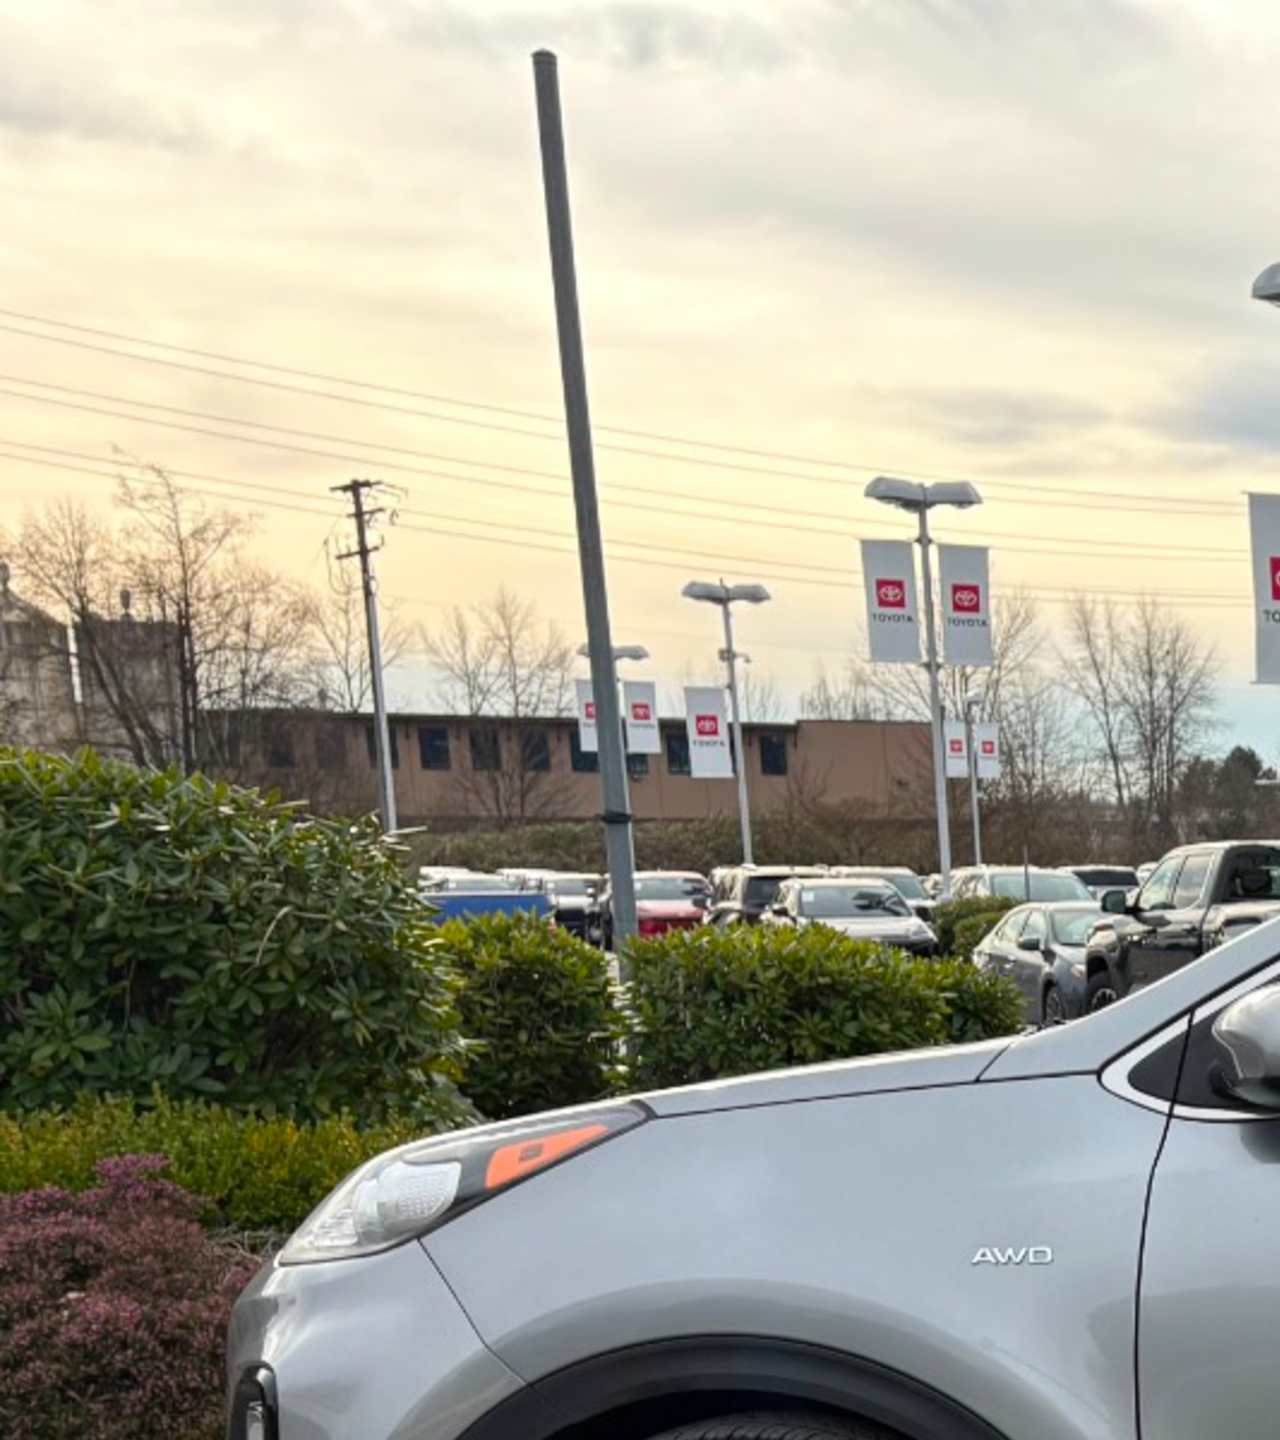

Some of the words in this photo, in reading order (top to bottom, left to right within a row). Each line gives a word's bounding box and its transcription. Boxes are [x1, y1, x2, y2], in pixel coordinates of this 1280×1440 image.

[872, 613, 914, 622] TOYOTA
[947, 617, 988, 627] TOYOTA
[971, 1246, 1054, 1265] AWD
